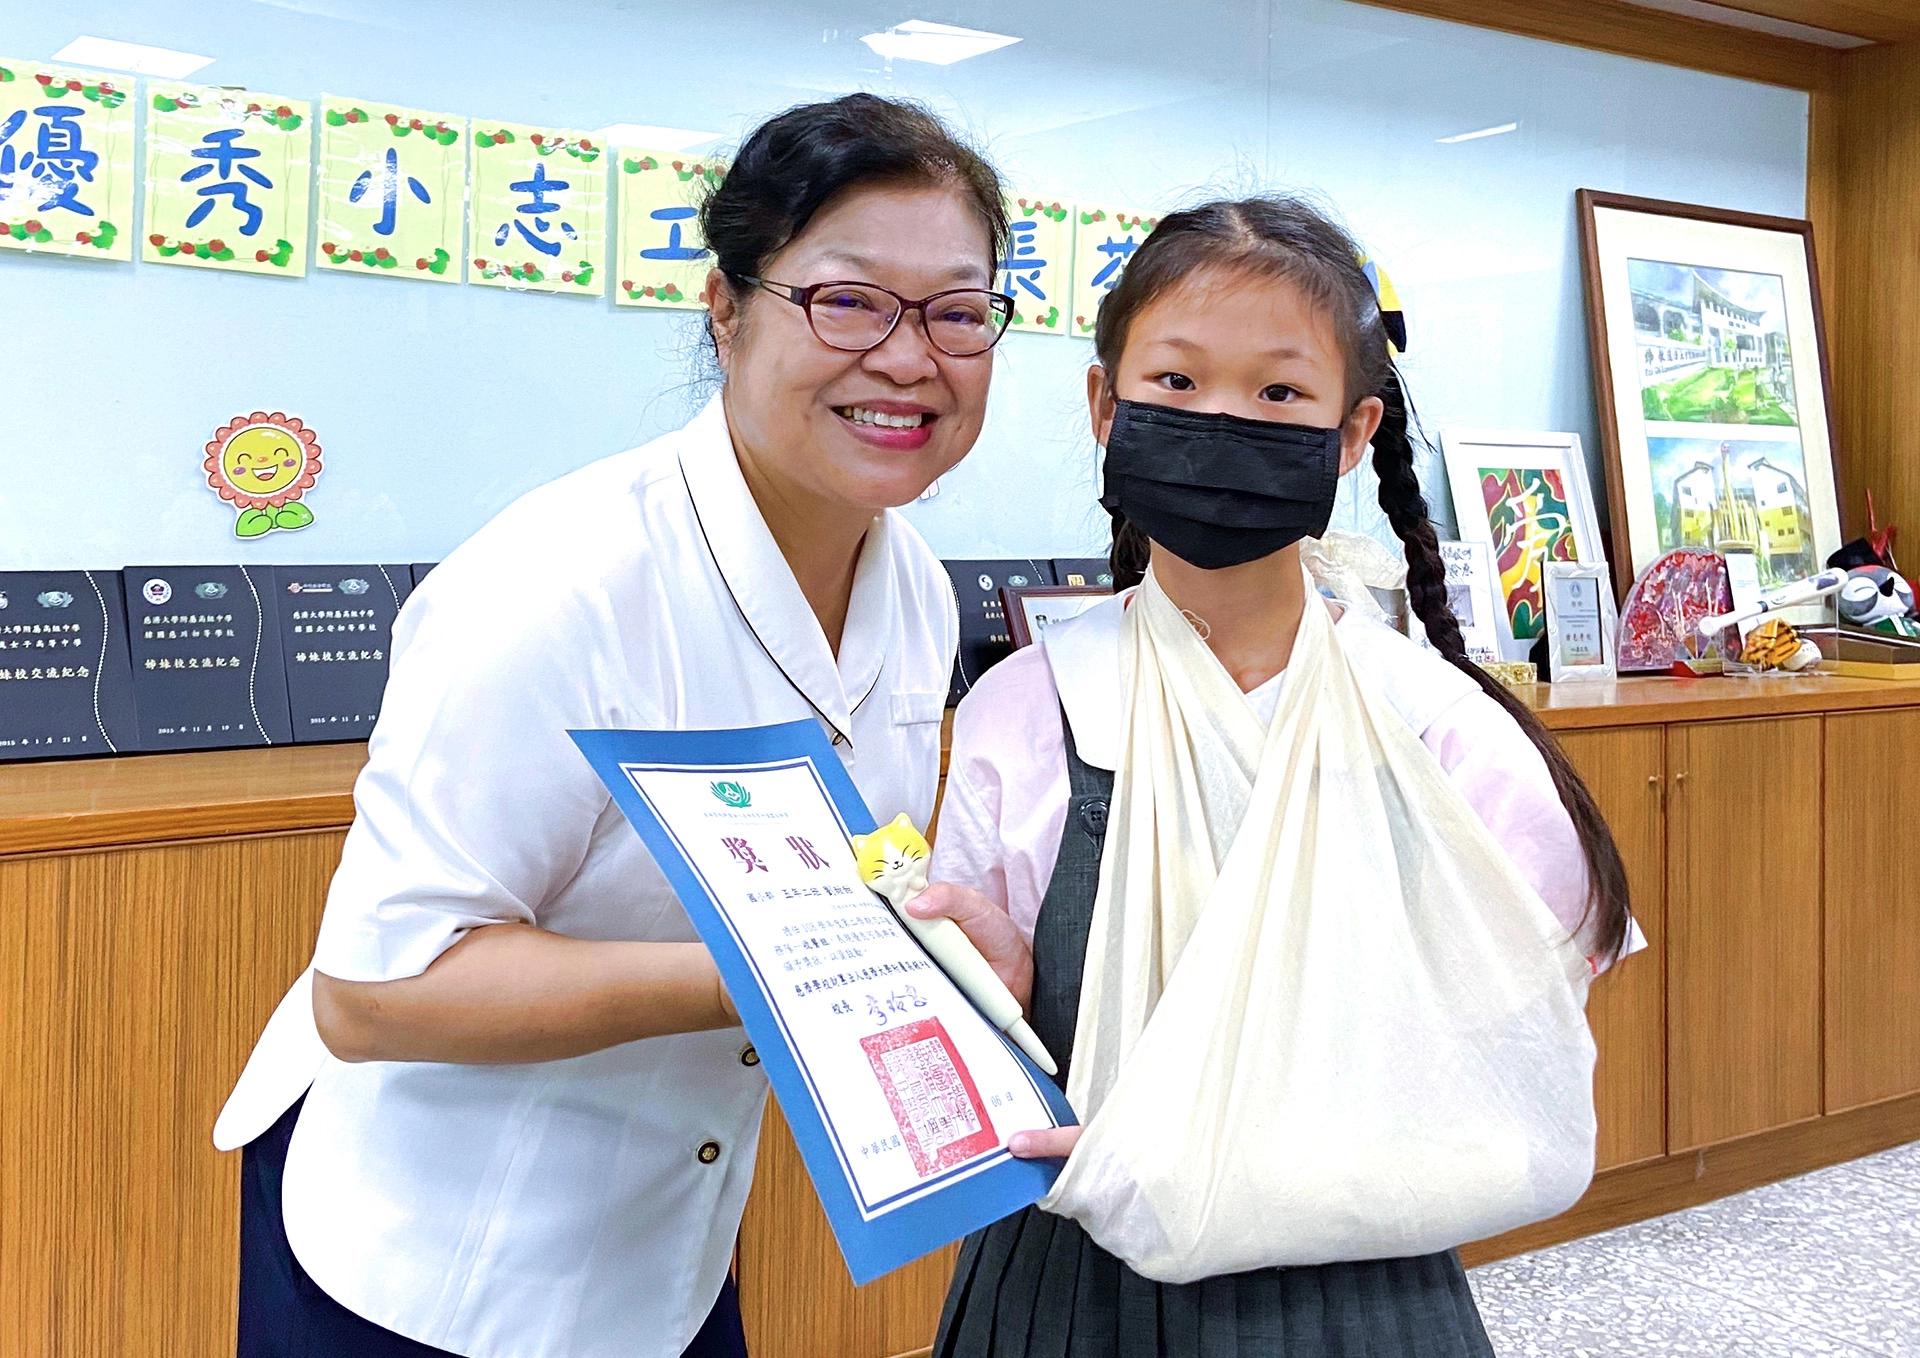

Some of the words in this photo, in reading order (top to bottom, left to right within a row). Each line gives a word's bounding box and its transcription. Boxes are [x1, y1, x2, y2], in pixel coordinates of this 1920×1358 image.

[0, 104, 709, 262] 優秀小志工
[0, 623, 81, 635] 大學附屬高級中學
[144, 656, 241, 670] 姊妹校交流紀念
[295, 649, 384, 663] 姊妹校交流紀念
[720, 835, 832, 874] 獎狀
[861, 1134, 902, 1159] 中華民國
